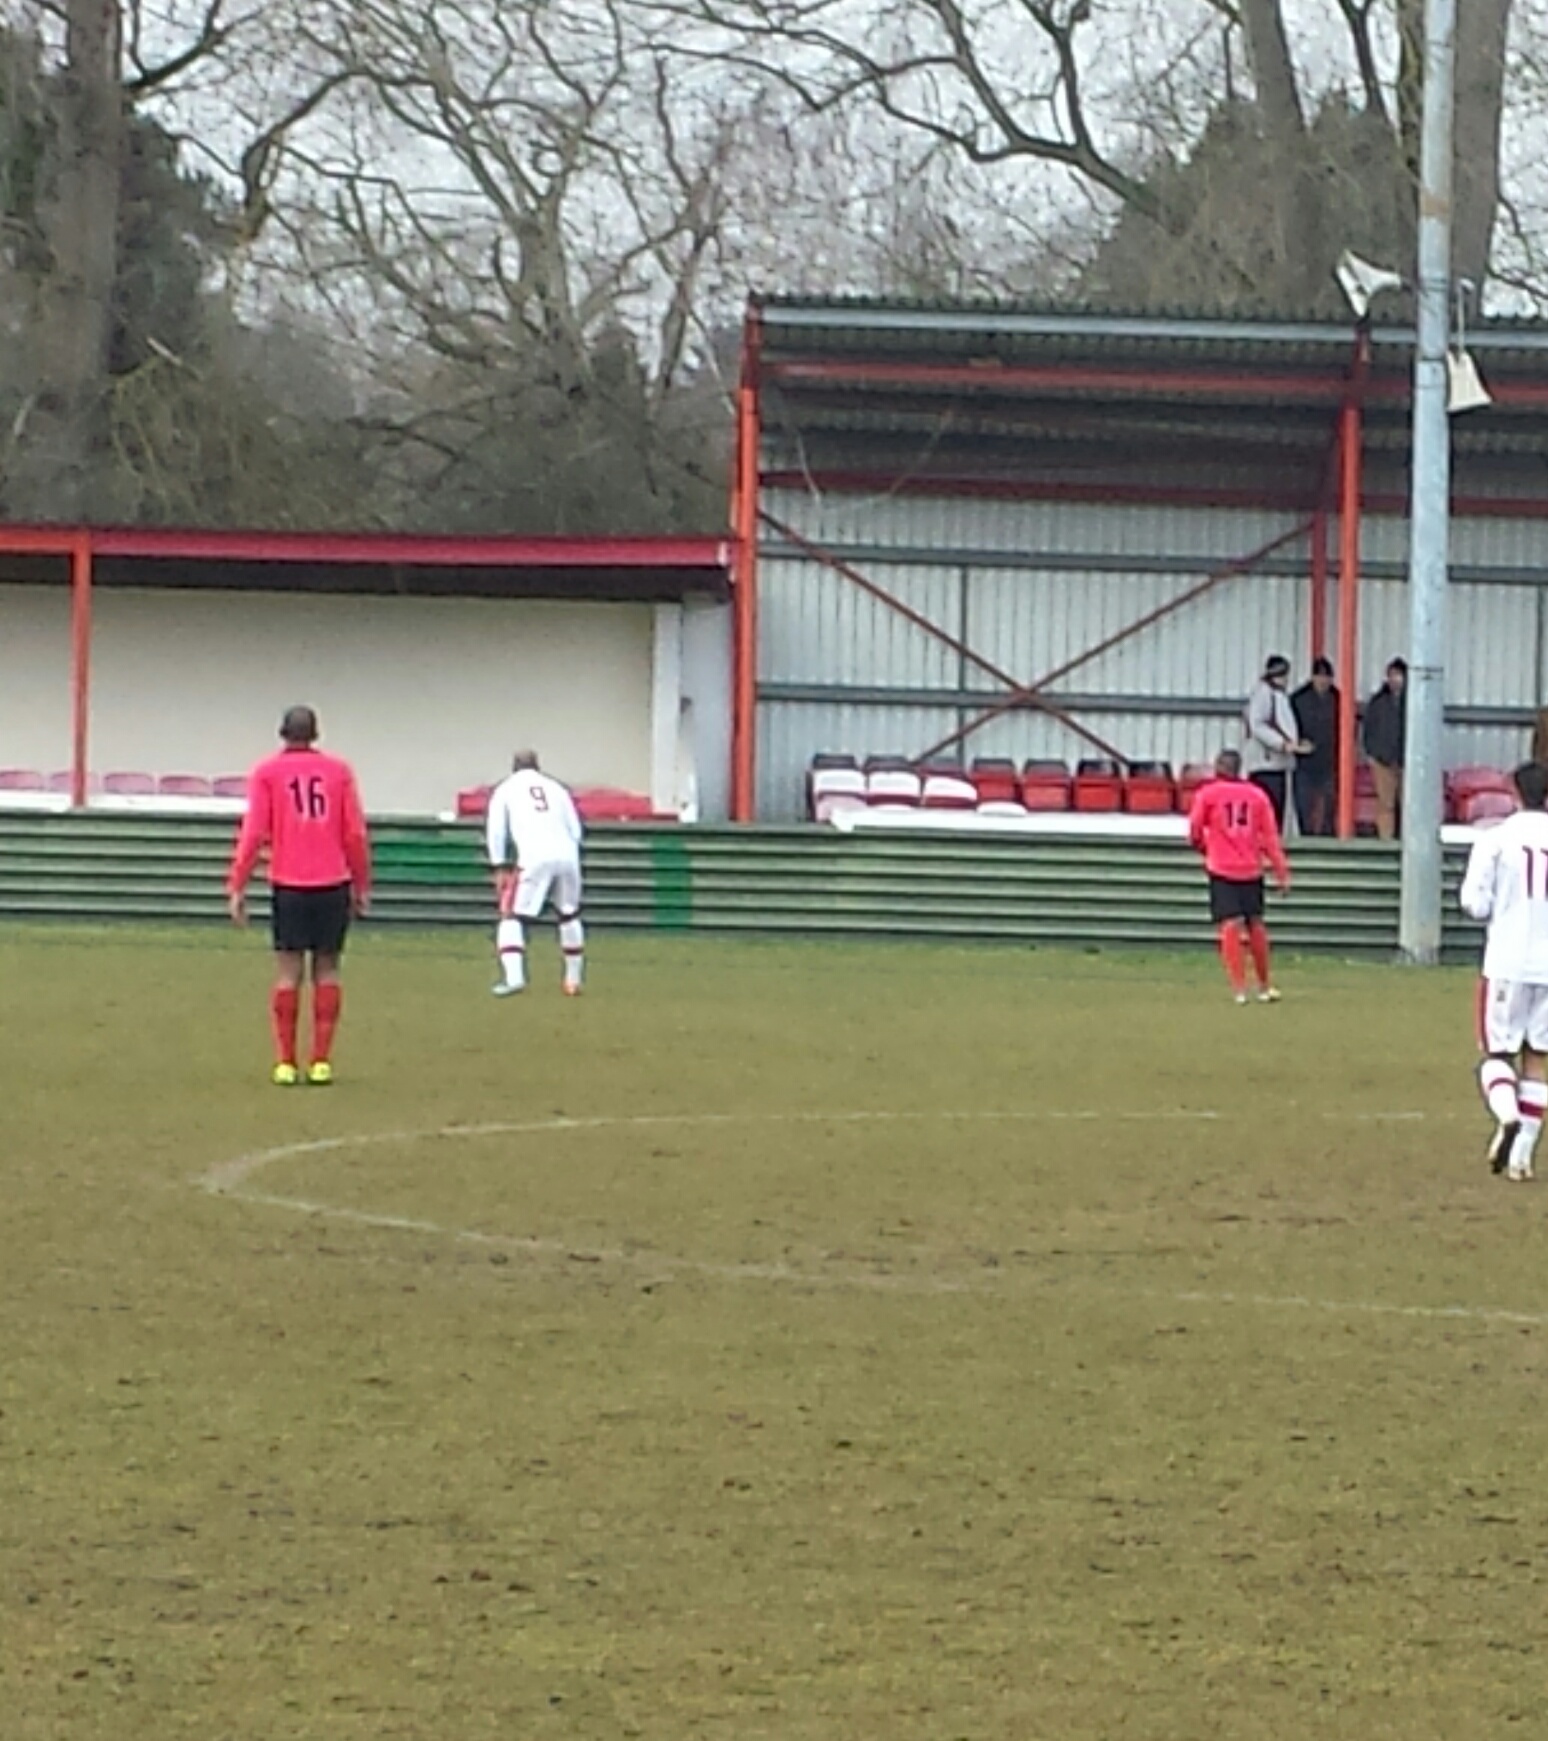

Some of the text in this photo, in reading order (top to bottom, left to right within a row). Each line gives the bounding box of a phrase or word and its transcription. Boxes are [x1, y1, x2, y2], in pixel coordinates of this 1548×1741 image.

[288, 775, 326, 819] 16
[529, 785, 549, 812] 9
[1223, 801, 1248, 828] 14
